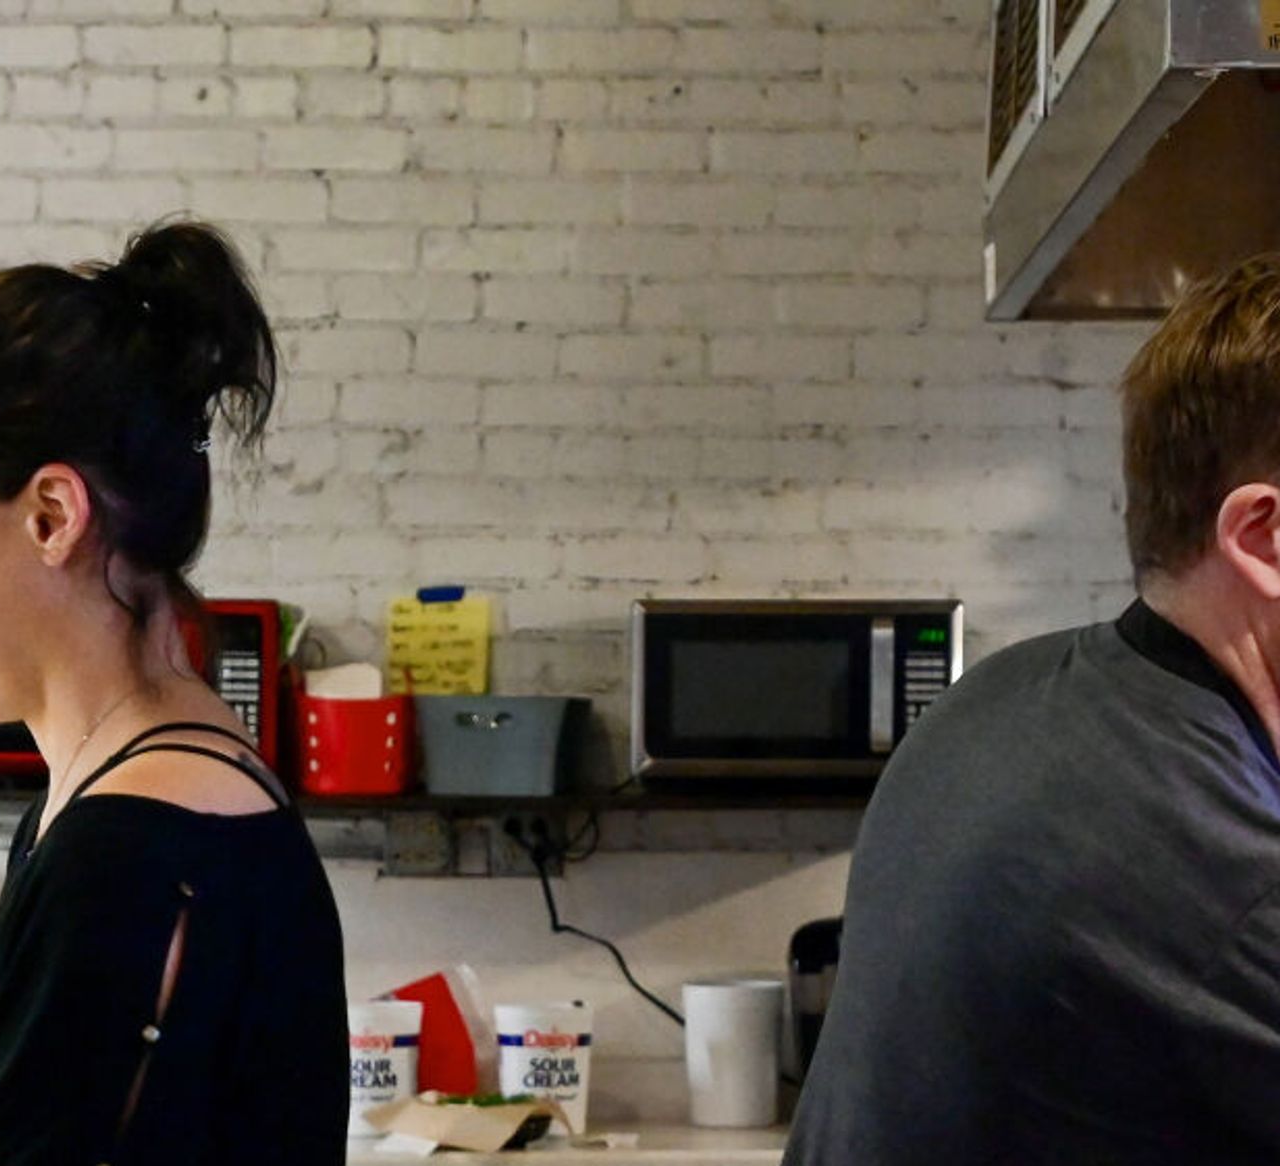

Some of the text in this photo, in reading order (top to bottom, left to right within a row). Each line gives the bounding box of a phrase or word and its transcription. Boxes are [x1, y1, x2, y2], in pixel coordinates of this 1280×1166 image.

[530, 1057, 576, 1072] SOUR
[351, 1073, 398, 1089] REAM
[523, 1072, 580, 1088] CREAM
